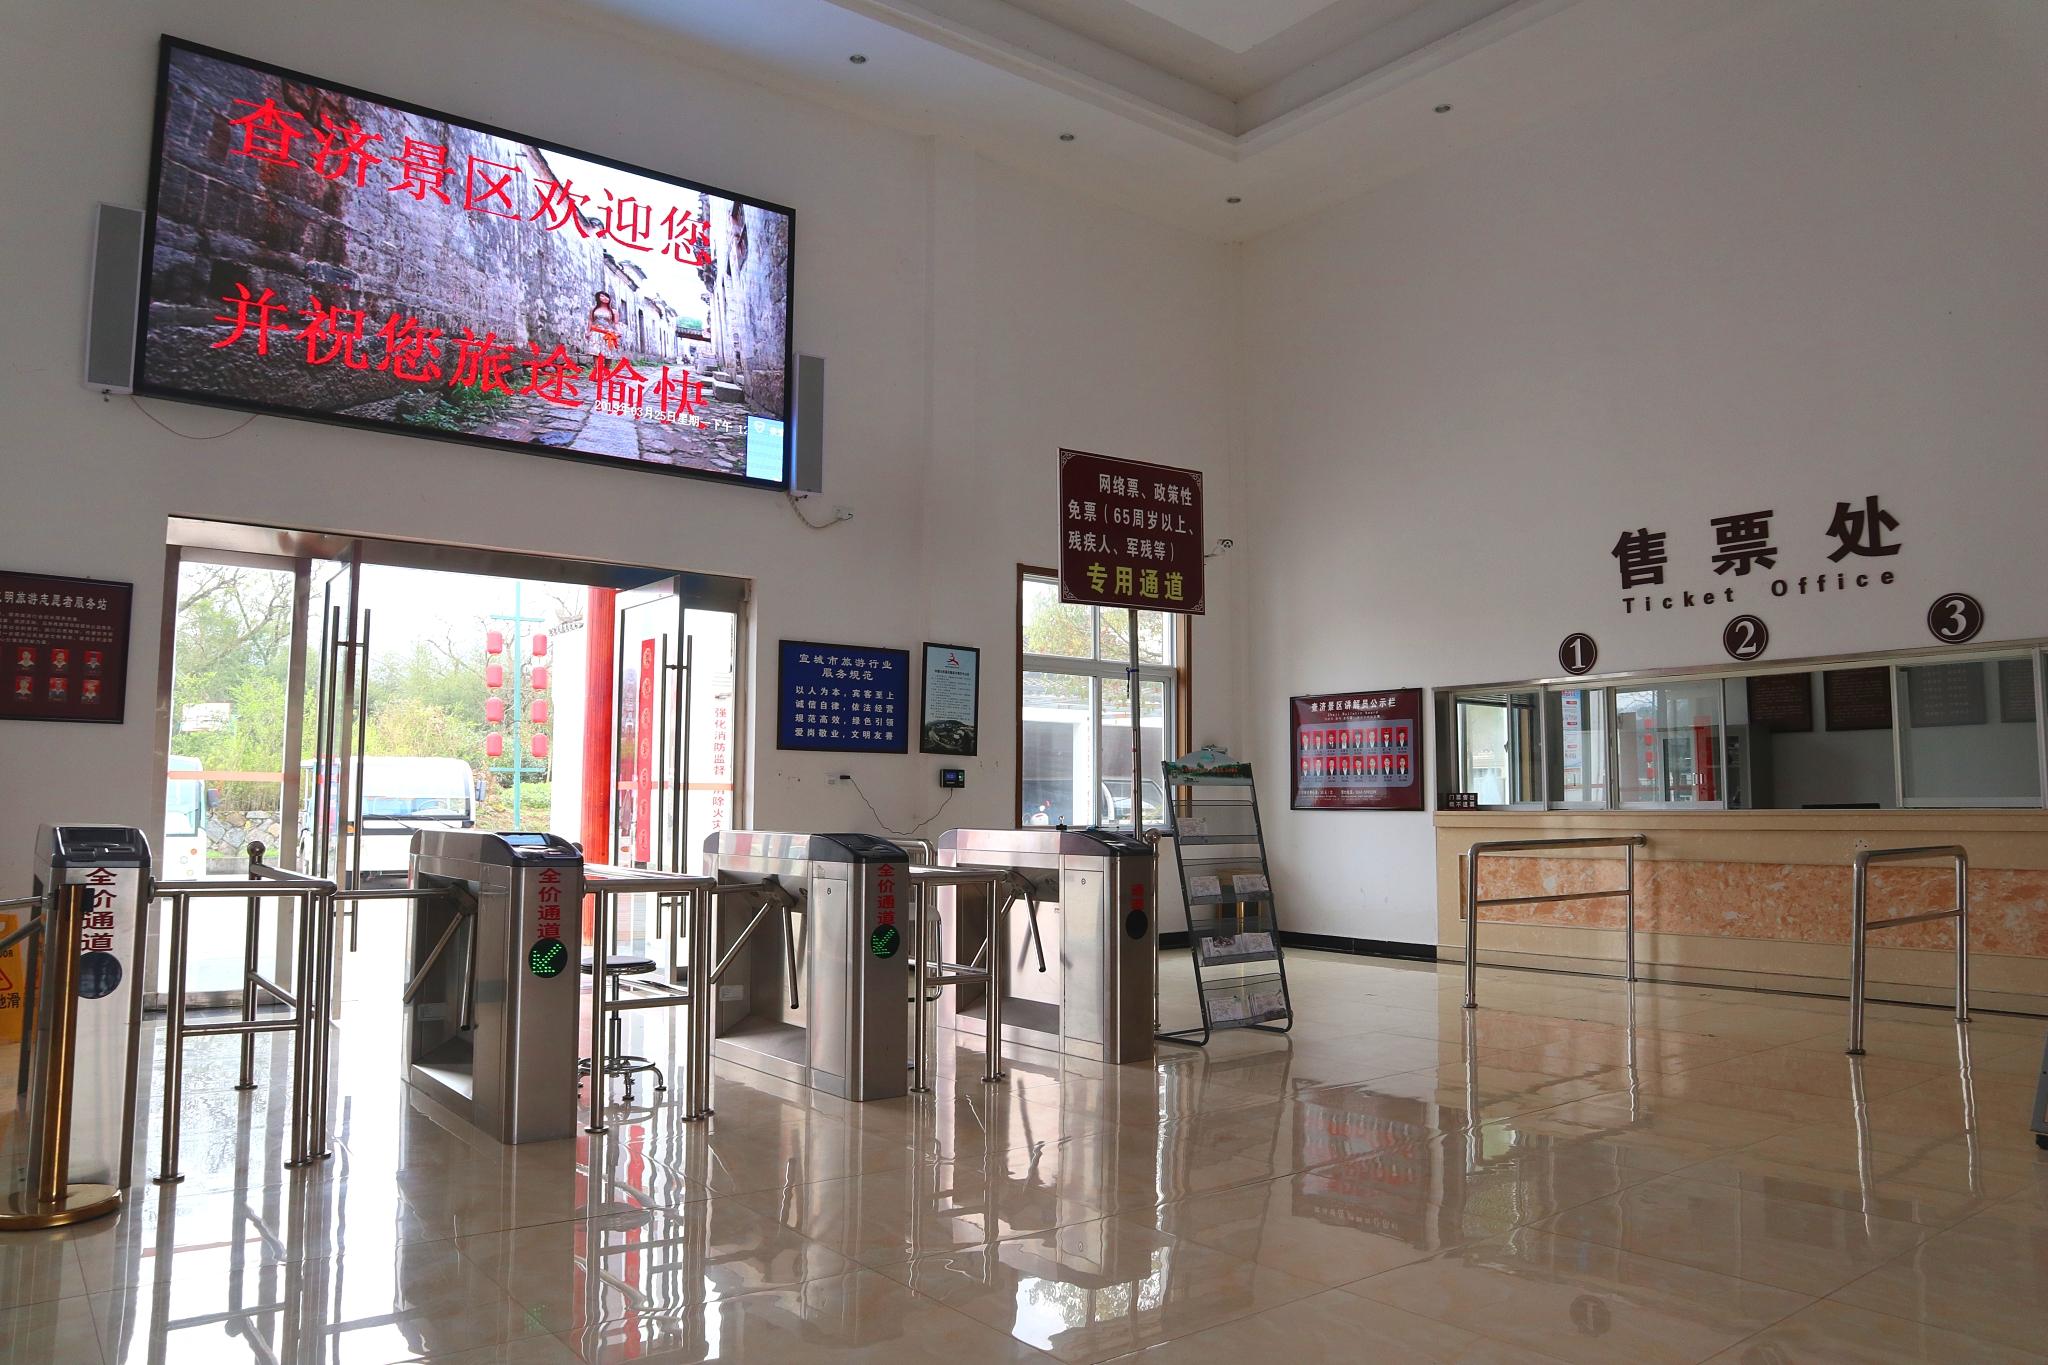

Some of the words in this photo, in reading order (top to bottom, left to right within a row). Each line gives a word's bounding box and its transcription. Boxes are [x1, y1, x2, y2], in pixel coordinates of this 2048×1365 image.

[228, 98, 713, 267] 查济景区欢迎您
[211, 281, 709, 430] 并祝您旅途愉快
[1099, 473, 1193, 507] 网络票、政策性
[1068, 530, 1174, 562] 残疾人、军残等）
[1611, 495, 1902, 590] 售票处
[0, 590, 108, 611] 明旅游志愿者服务站
[1086, 562, 1184, 601] 专用通道
[1622, 587, 1735, 614] Ticket
[1770, 570, 1896, 598] Office
[1941, 599, 1968, 636] 3
[1570, 638, 1587, 669] 1
[1734, 620, 1758, 655] 2
[799, 653, 893, 670] 宣城市旅游行业
[821, 667, 874, 681] 服务规范
[81, 867, 118, 952] 全价通道
[538, 868, 562, 939] 全价通道
[877, 863, 896, 926] 全价通道
